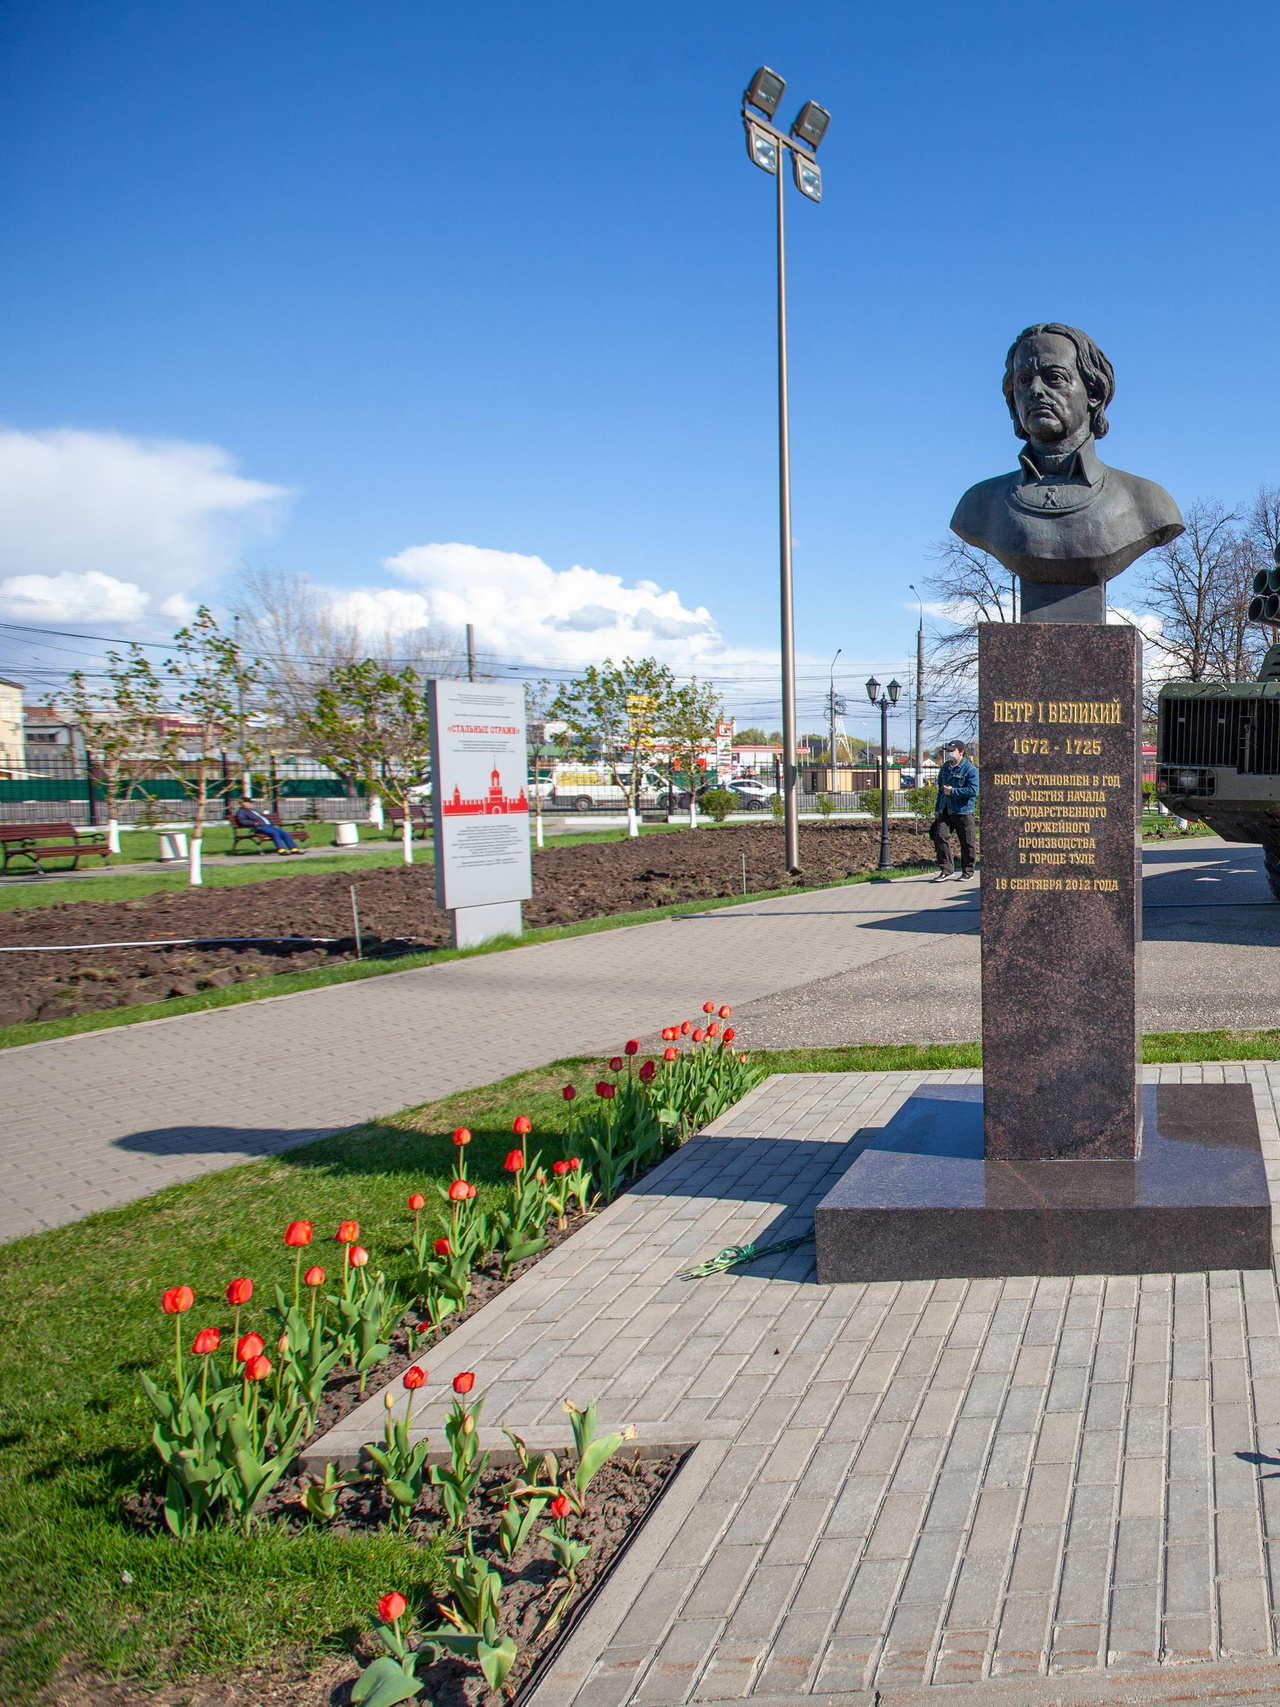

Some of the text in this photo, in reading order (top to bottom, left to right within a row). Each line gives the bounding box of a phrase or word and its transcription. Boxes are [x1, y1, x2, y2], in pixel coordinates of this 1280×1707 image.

[993, 700, 1034, 723] ПЕТР
[1048, 698, 1122, 724] ВЕЛИКИЙ
[1012, 738, 1049, 755] 1672
[1065, 738, 1102, 755] 1725
[993, 773, 1121, 788] БЮСТ УСТАНОВЛЕН В ГОД
[1008, 789, 1106, 802] 300-ЛЕТИЯ НАЧАЛА
[1007, 805, 1107, 818] ГОСУДАРСТВЕННОГО
[1024, 820, 1091, 834] ОРУЖЕЙНОГО
[1018, 836, 1096, 850] ПРОИЗВОДСТВА
[1019, 852, 1096, 866] В ГОРОДЕ ТУЛЕ
[995, 878, 1119, 893] 19 СЕНТЯБРЯ 2012 ГОДА
